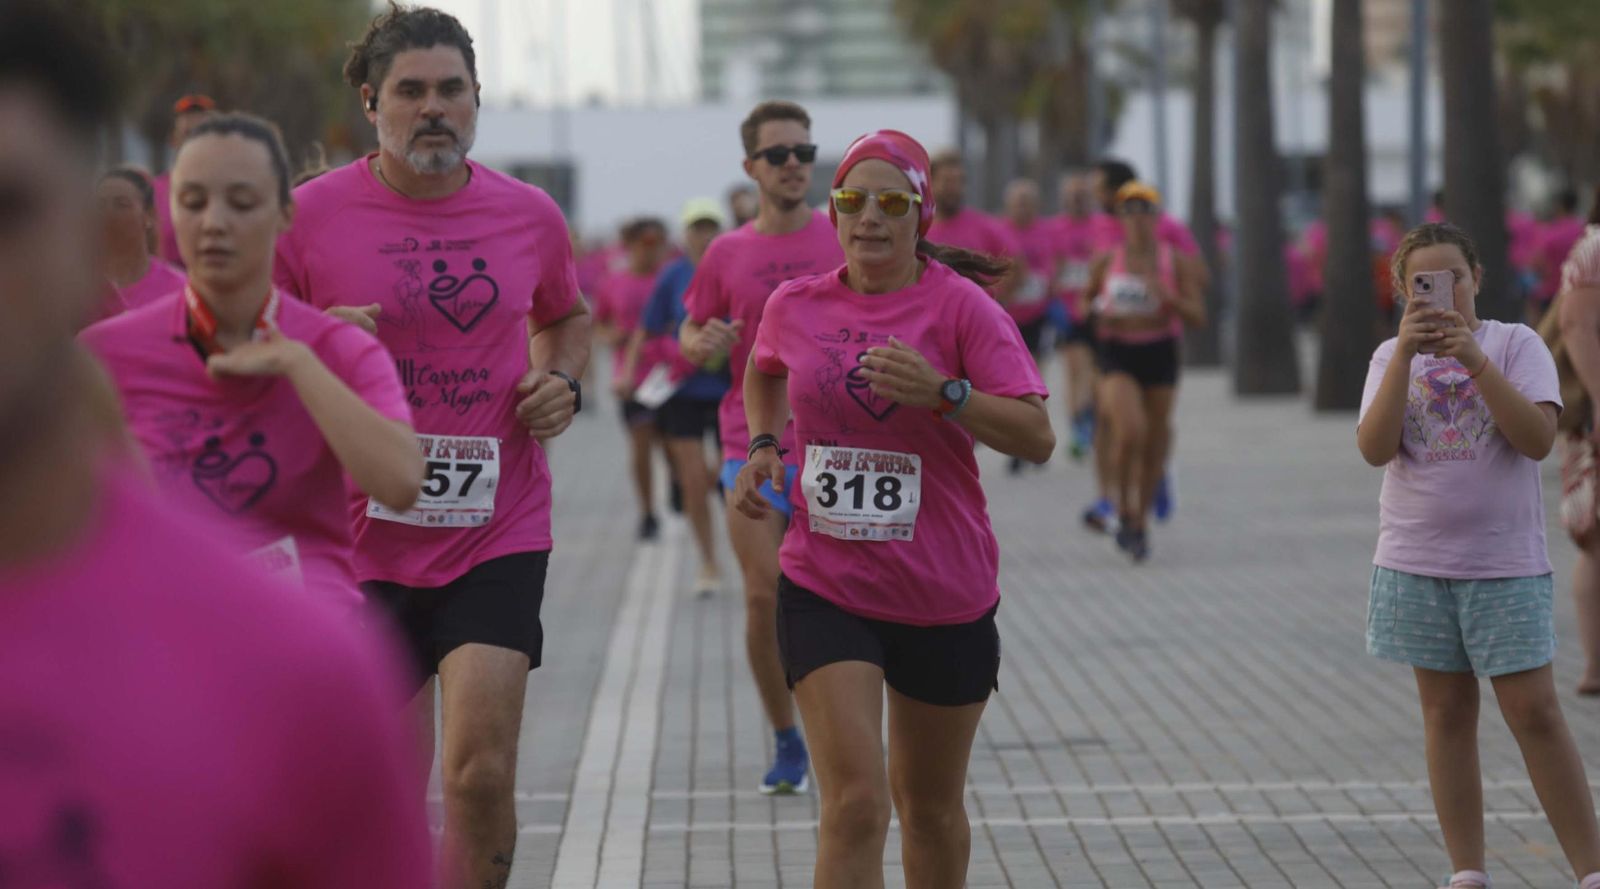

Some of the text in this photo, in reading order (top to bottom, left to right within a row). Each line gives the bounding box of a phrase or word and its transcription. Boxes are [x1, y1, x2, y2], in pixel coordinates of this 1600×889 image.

[417, 364, 489, 385] Carrera
[440, 385, 492, 416] Mujer
[438, 439, 490, 450] CARRERA
[435, 447, 451, 459] LA
[455, 449, 495, 461] MUJER
[831, 450, 912, 465] VIII CARRERA
[825, 459, 916, 475] POR LA MUJER
[815, 472, 902, 511] 318
